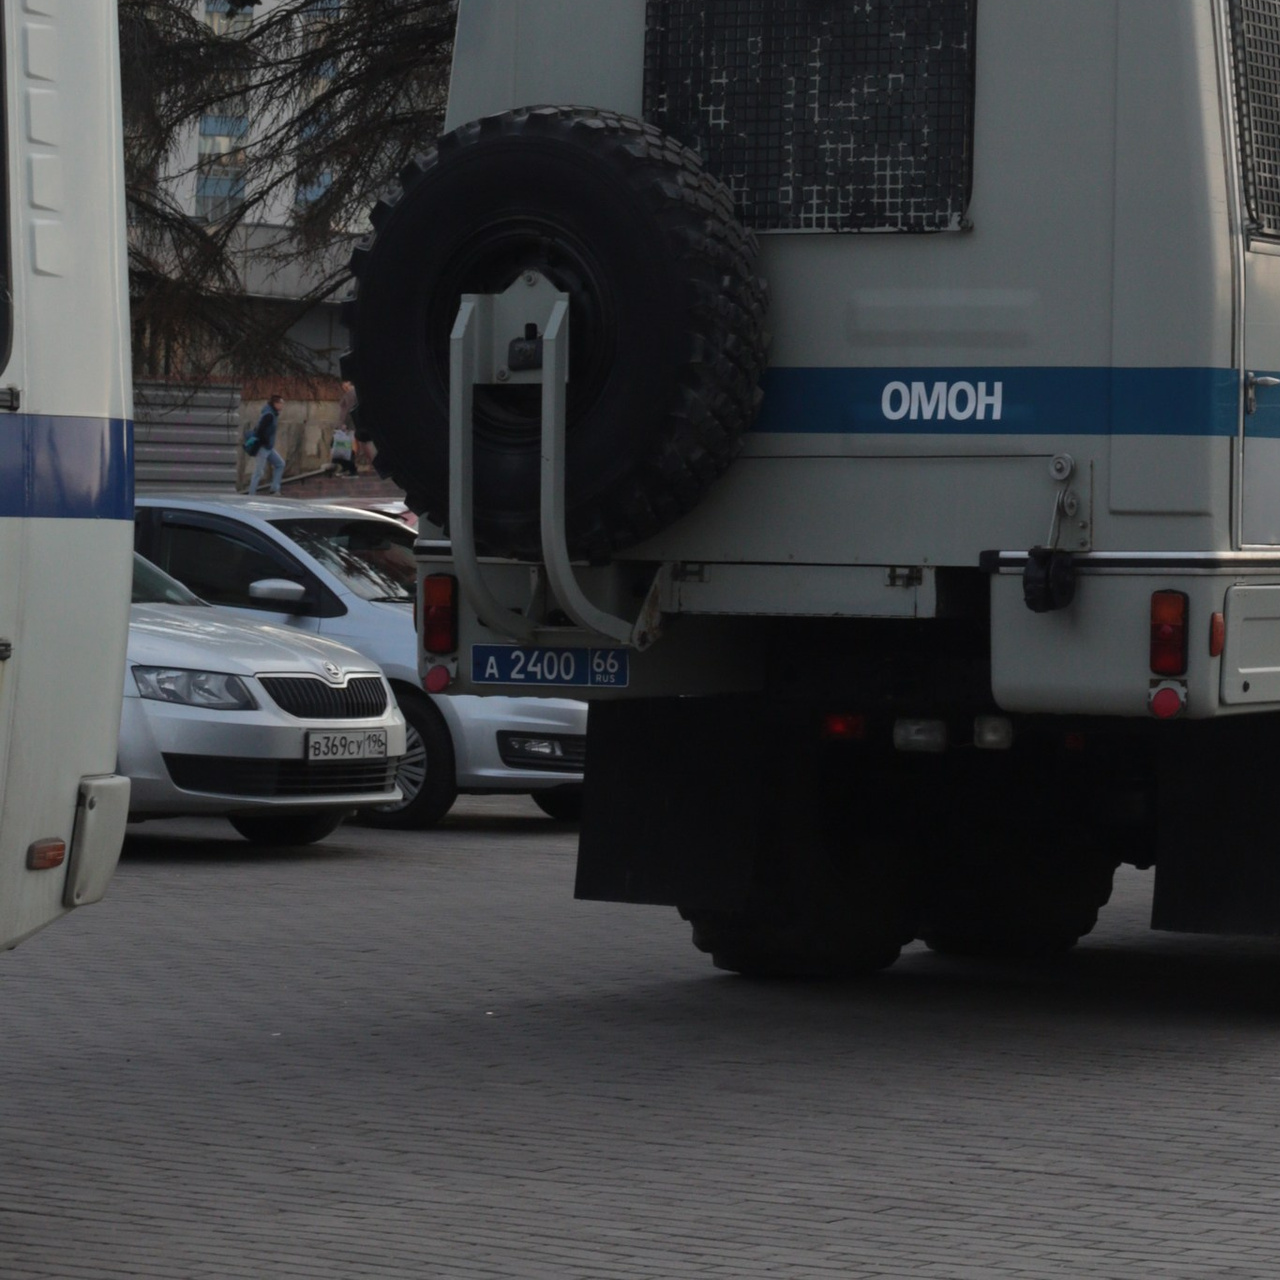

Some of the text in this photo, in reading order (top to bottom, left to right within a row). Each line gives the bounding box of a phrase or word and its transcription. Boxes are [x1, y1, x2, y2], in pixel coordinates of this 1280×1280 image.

[881, 381, 1003, 420] ОМОН
[485, 650, 619, 680] А 2400 66
[595, 674, 616, 683] RUS
[313, 733, 384, 757] В369СУ 196
